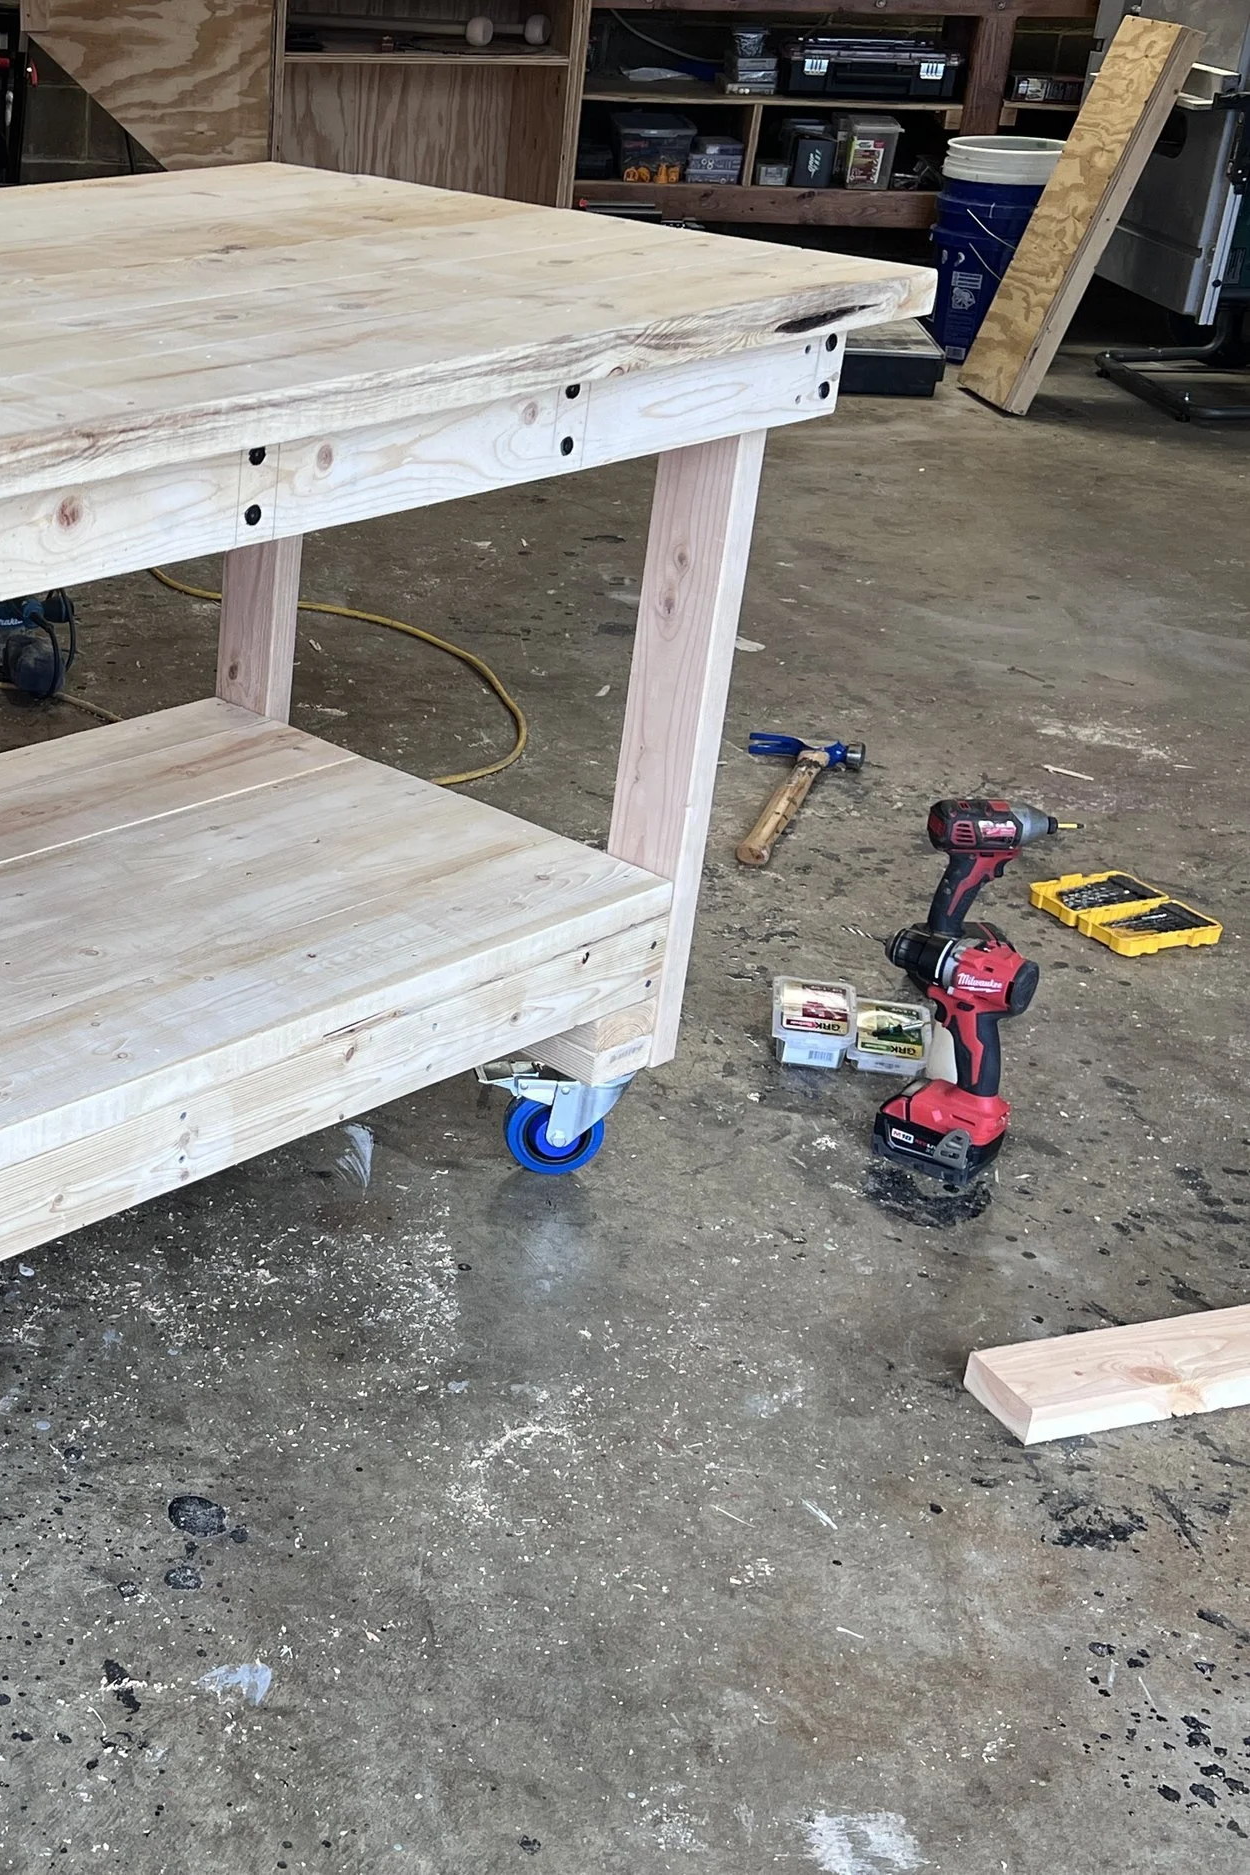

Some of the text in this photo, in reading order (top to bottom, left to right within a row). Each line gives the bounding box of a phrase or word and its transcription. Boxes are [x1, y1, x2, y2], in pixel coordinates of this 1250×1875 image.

[957, 972, 1002, 989] Milwaukee
[815, 1021, 841, 1032] GRK
[890, 1045, 916, 1056] GRK
